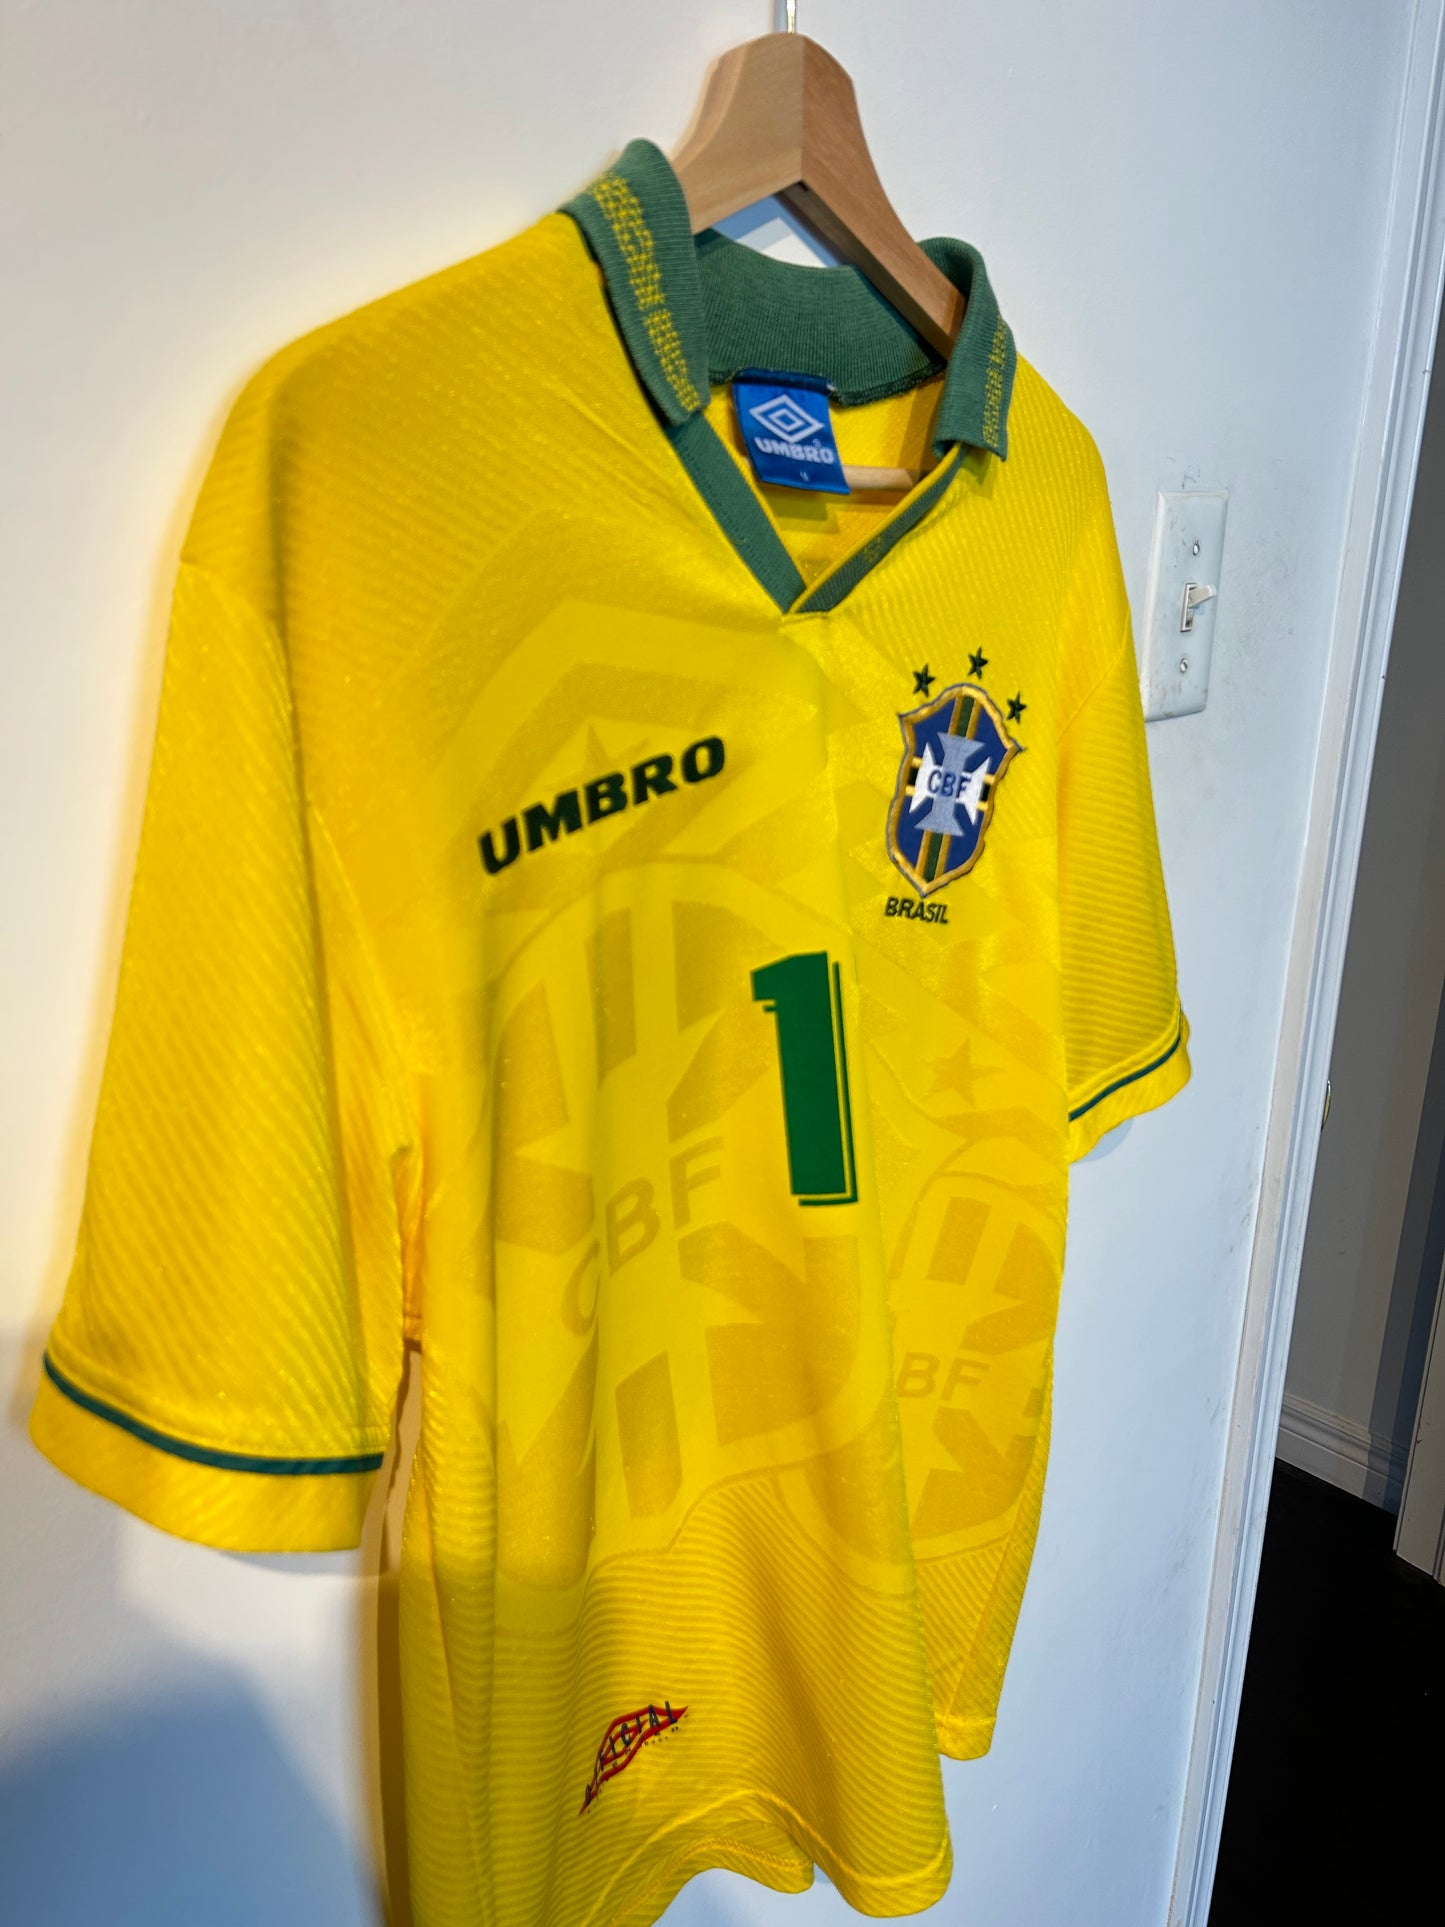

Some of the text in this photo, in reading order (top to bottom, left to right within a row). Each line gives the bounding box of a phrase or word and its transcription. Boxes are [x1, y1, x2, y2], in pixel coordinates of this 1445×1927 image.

[754, 436, 835, 464] UMBRO
[477, 735, 726, 875] UMBRO
[926, 769, 972, 798] CBF
[884, 896, 949, 924] BRASIL
[750, 950, 859, 1207] 1
[560, 1135, 725, 1338] CBF
